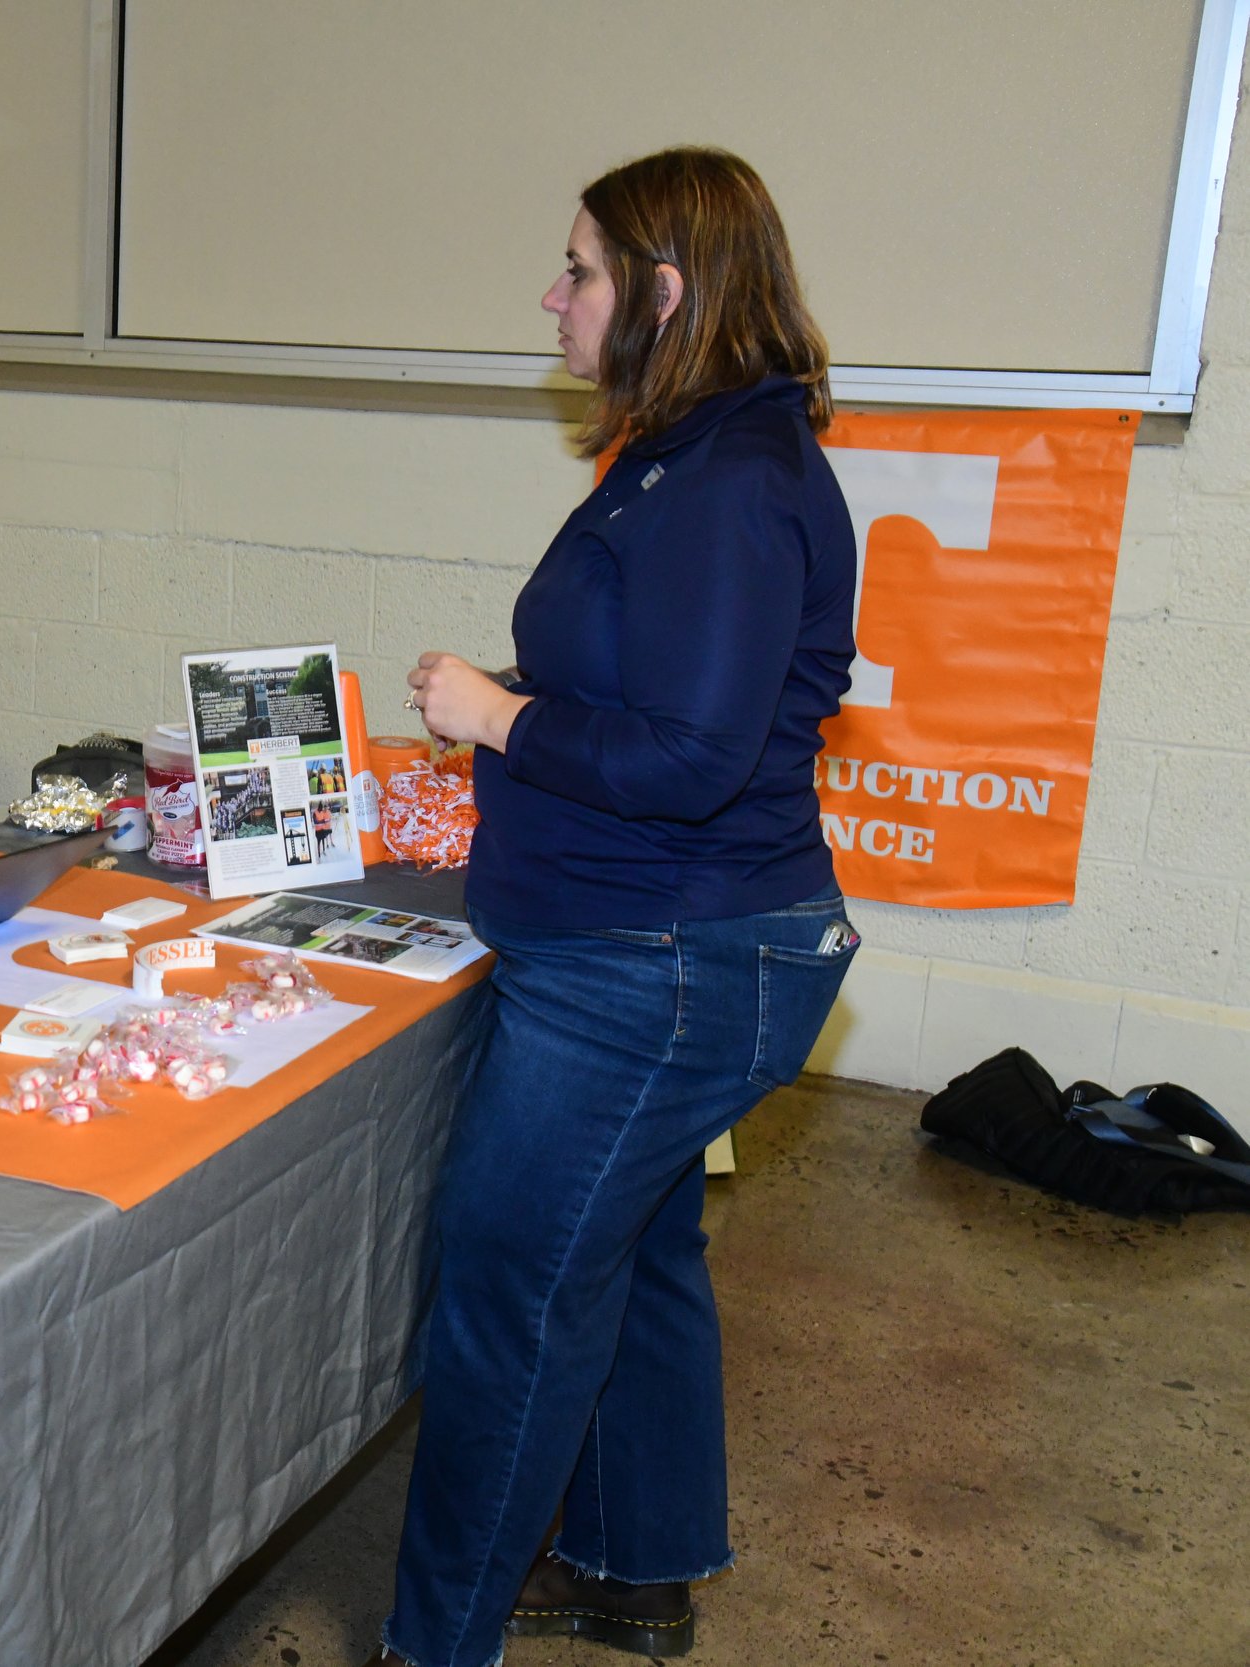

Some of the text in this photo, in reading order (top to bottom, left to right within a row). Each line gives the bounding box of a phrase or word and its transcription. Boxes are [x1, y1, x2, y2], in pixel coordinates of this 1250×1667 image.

[229, 670, 299, 683] CONSTRUCTION SCIENCE
[199, 691, 221, 699] Leaders
[260, 738, 299, 750] HERBERT
[169, 792, 191, 806] Bird
[820, 813, 935, 864] NCE
